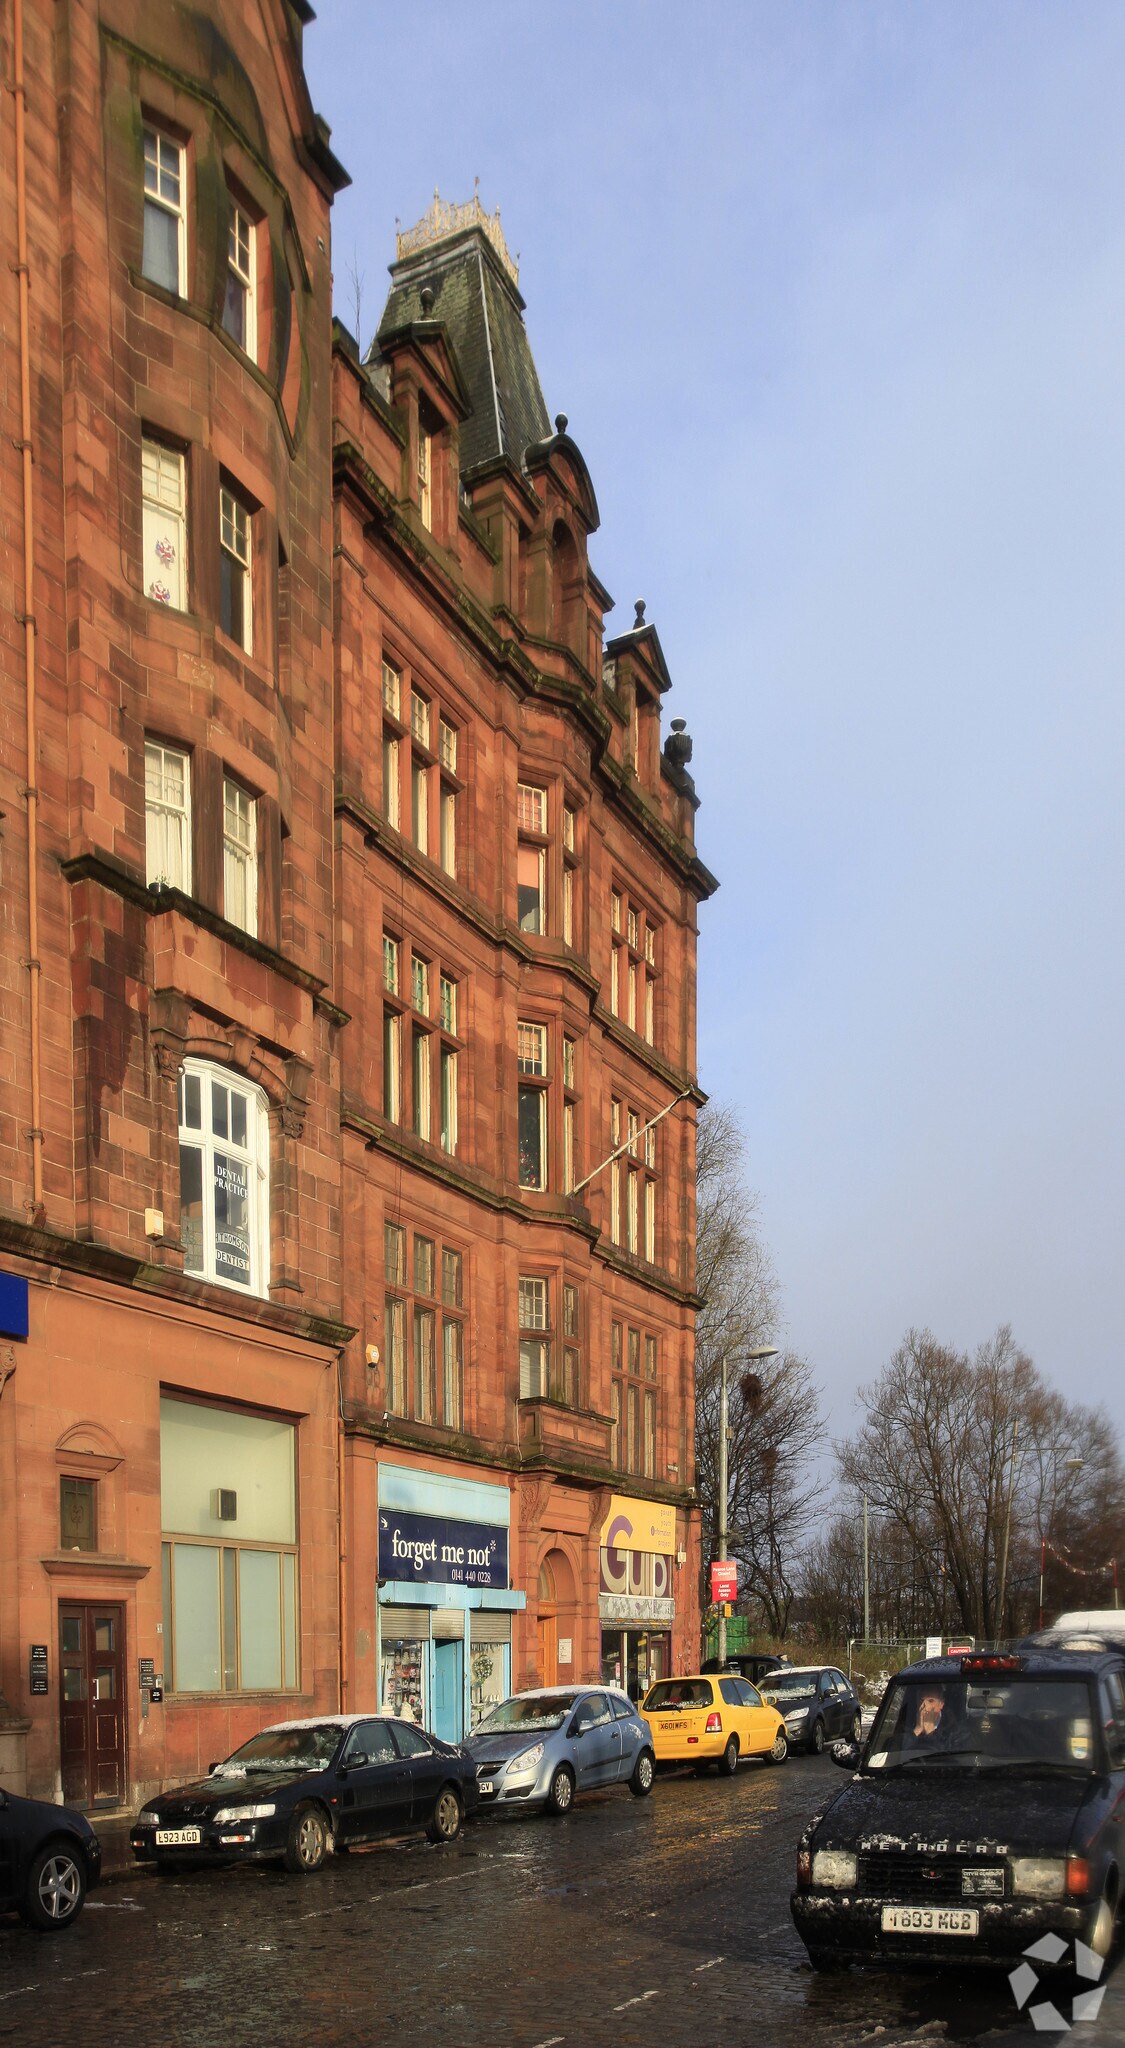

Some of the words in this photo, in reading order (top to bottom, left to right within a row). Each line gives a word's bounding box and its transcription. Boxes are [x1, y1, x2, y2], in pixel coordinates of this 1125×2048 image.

[217, 1165, 246, 1186] DENTAL
[214, 1175, 248, 1198] PRACTICE
[216, 1250, 248, 1269] DENTIST
[392, 1529, 437, 1570] forget
[441, 1545, 465, 1564] me
[467, 1545, 491, 1567] not
[451, 1568, 463, 1581] 0141
[465, 1570, 476, 1582] 440
[477, 1572, 491, 1583] 0228
[158, 1832, 179, 1843] L923
[181, 1831, 198, 1842] AGD
[861, 1842, 1008, 1854] METROCAB
